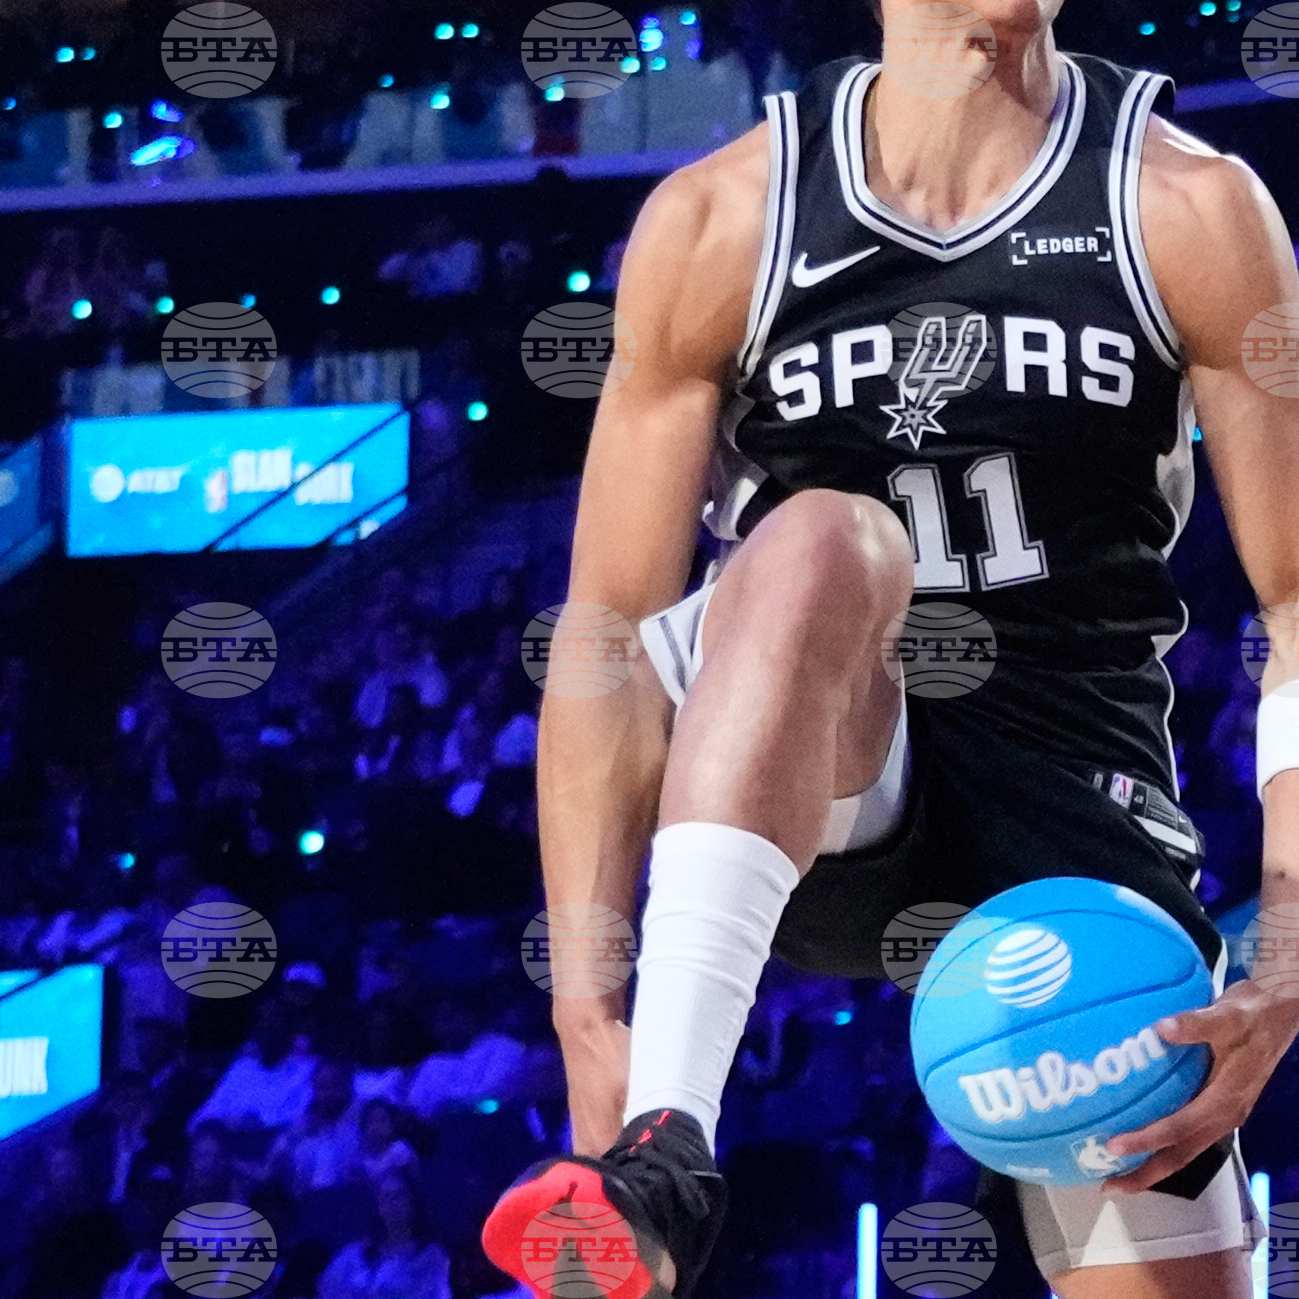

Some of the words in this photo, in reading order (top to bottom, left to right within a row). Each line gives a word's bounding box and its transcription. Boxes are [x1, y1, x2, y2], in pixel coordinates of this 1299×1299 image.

[1024, 236, 1099, 256] LEDGER
[768, 315, 1136, 423] SPURS
[887, 453, 1050, 594] 11
[957, 1026, 1167, 1123] Wilson
